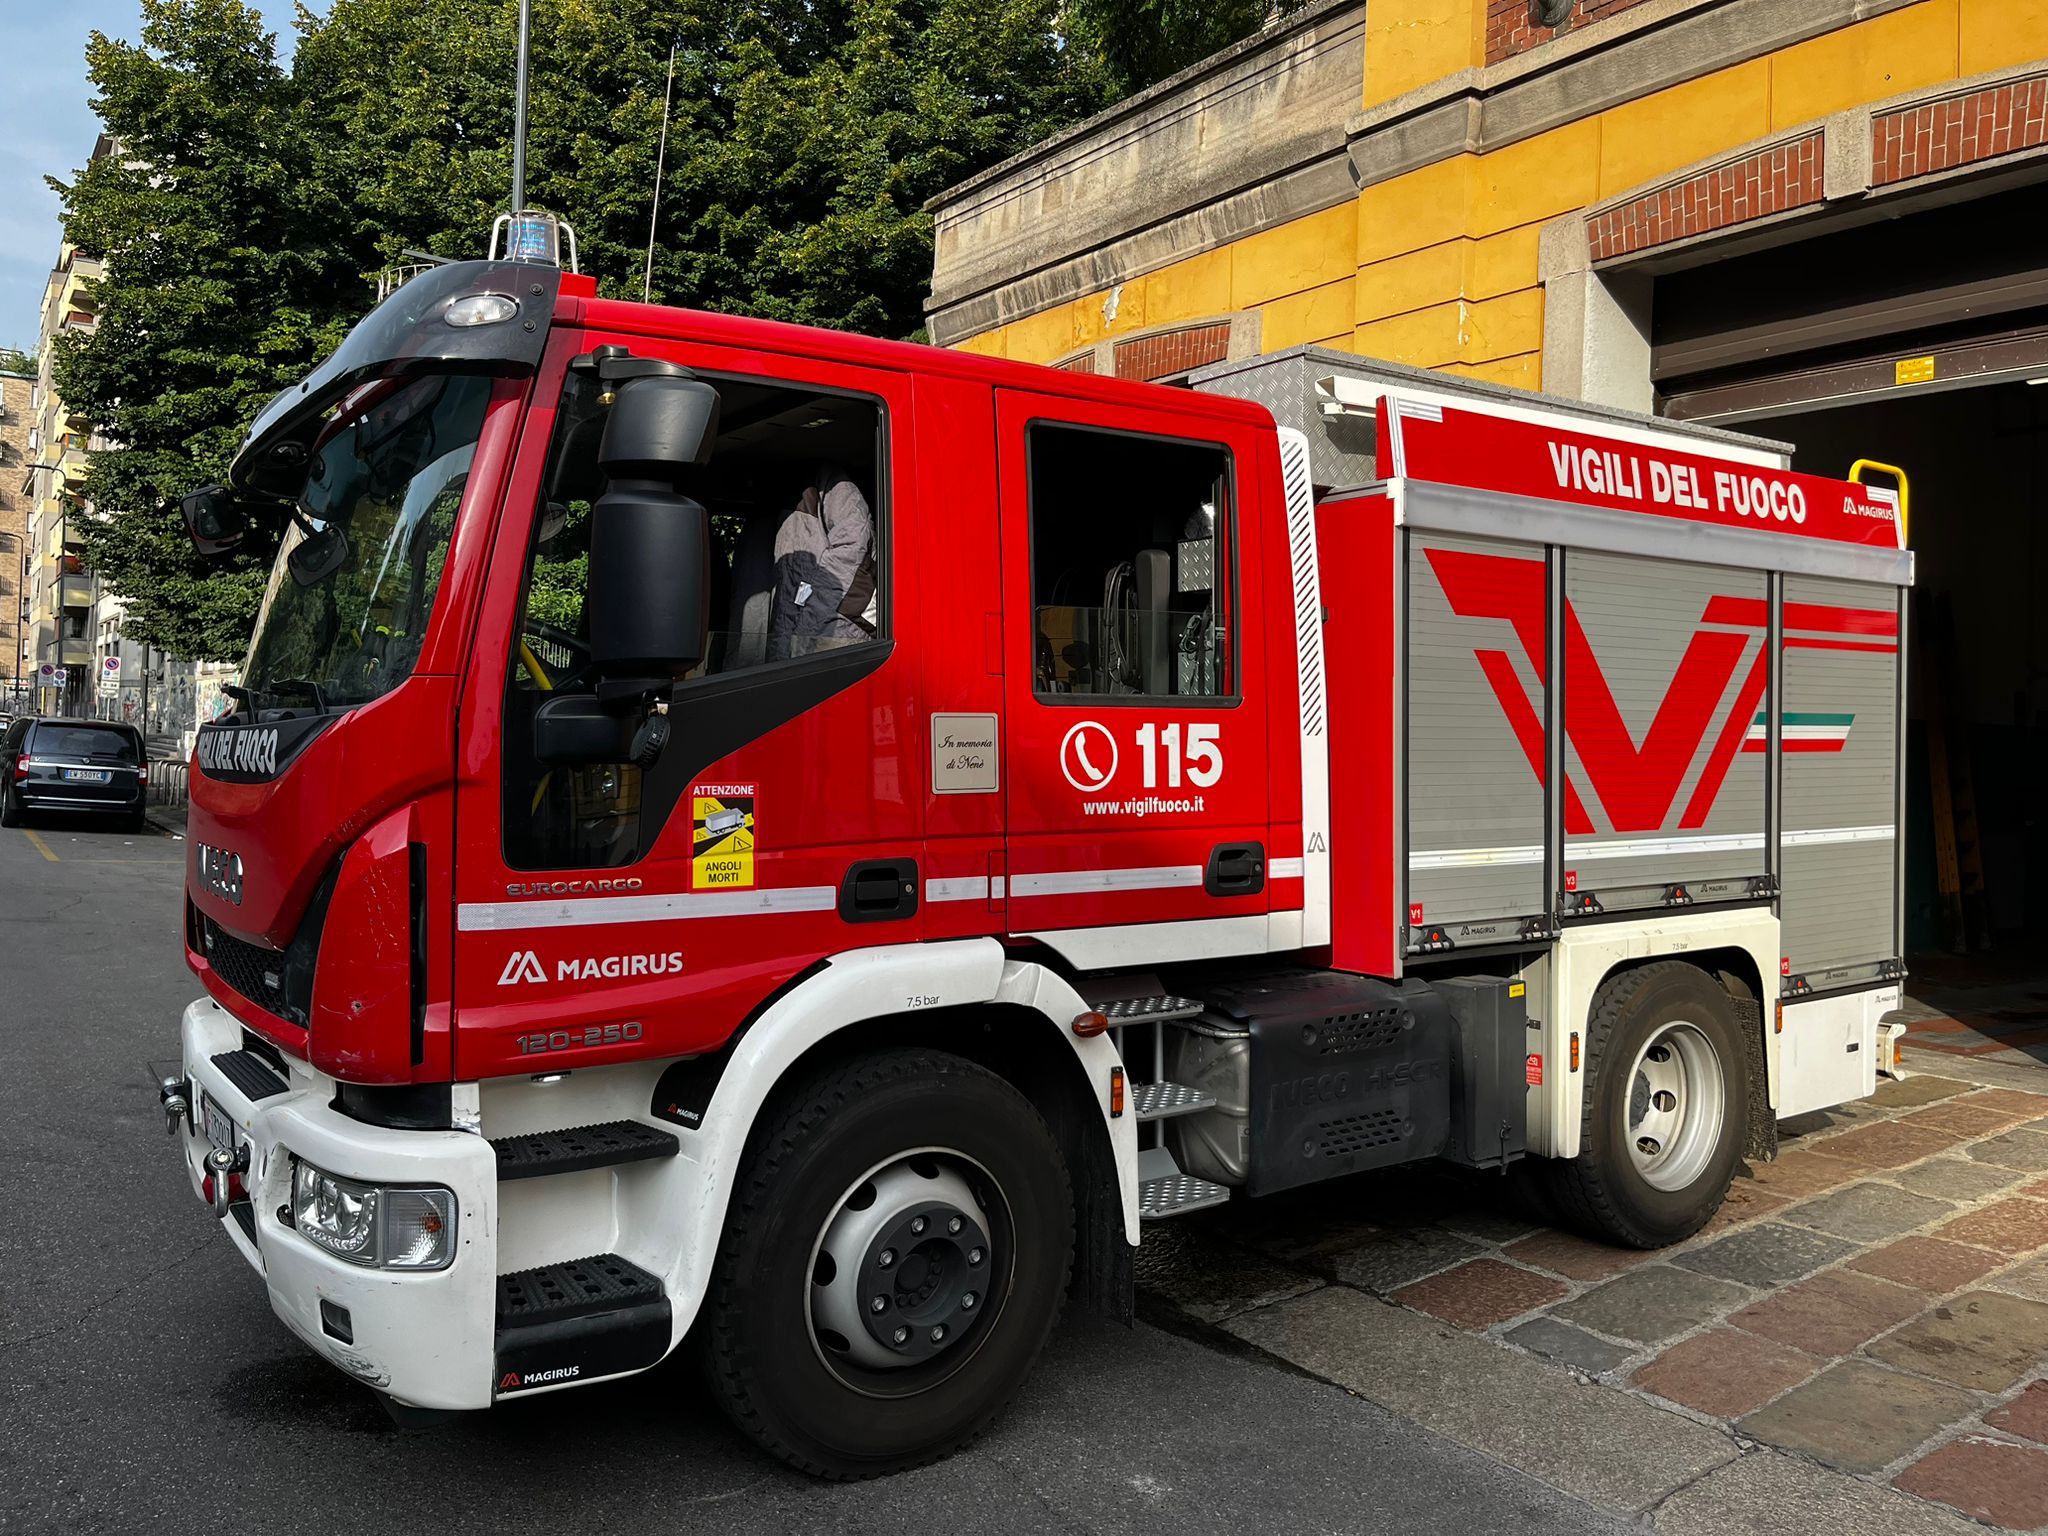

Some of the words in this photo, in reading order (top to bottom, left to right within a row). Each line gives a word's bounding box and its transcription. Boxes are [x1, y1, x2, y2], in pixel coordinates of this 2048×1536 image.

[1547, 441, 1643, 500] VIGILI
[1649, 459, 1709, 510] DEL
[1713, 471, 1806, 524] FUOCO
[1857, 504, 1894, 521] MAGIRUS
[937, 734, 954, 749] In
[956, 739, 993, 748] memoria
[215, 731, 234, 770] DEL
[234, 729, 278, 774] FUOCO
[1136, 723, 1223, 788] 115
[946, 758, 956, 770] di
[693, 785, 754, 796] ATTENZIONE
[1083, 796, 1205, 817] www.vigilfuoco.it
[705, 861, 742, 872] ANGOLI
[708, 872, 739, 883] MORTI
[506, 878, 643, 898] EUROCARGO
[1411, 909, 1421, 919] V1
[1471, 926, 1496, 935] MAGIRUS
[557, 952, 683, 982] MAGIRUS
[907, 996, 922, 1008] 7,5
[923, 994, 940, 1006] bar
[516, 1022, 643, 1055] 120-250
[676, 1107, 699, 1121] MAGIRUS
[523, 1366, 580, 1384] MAGIRUS
